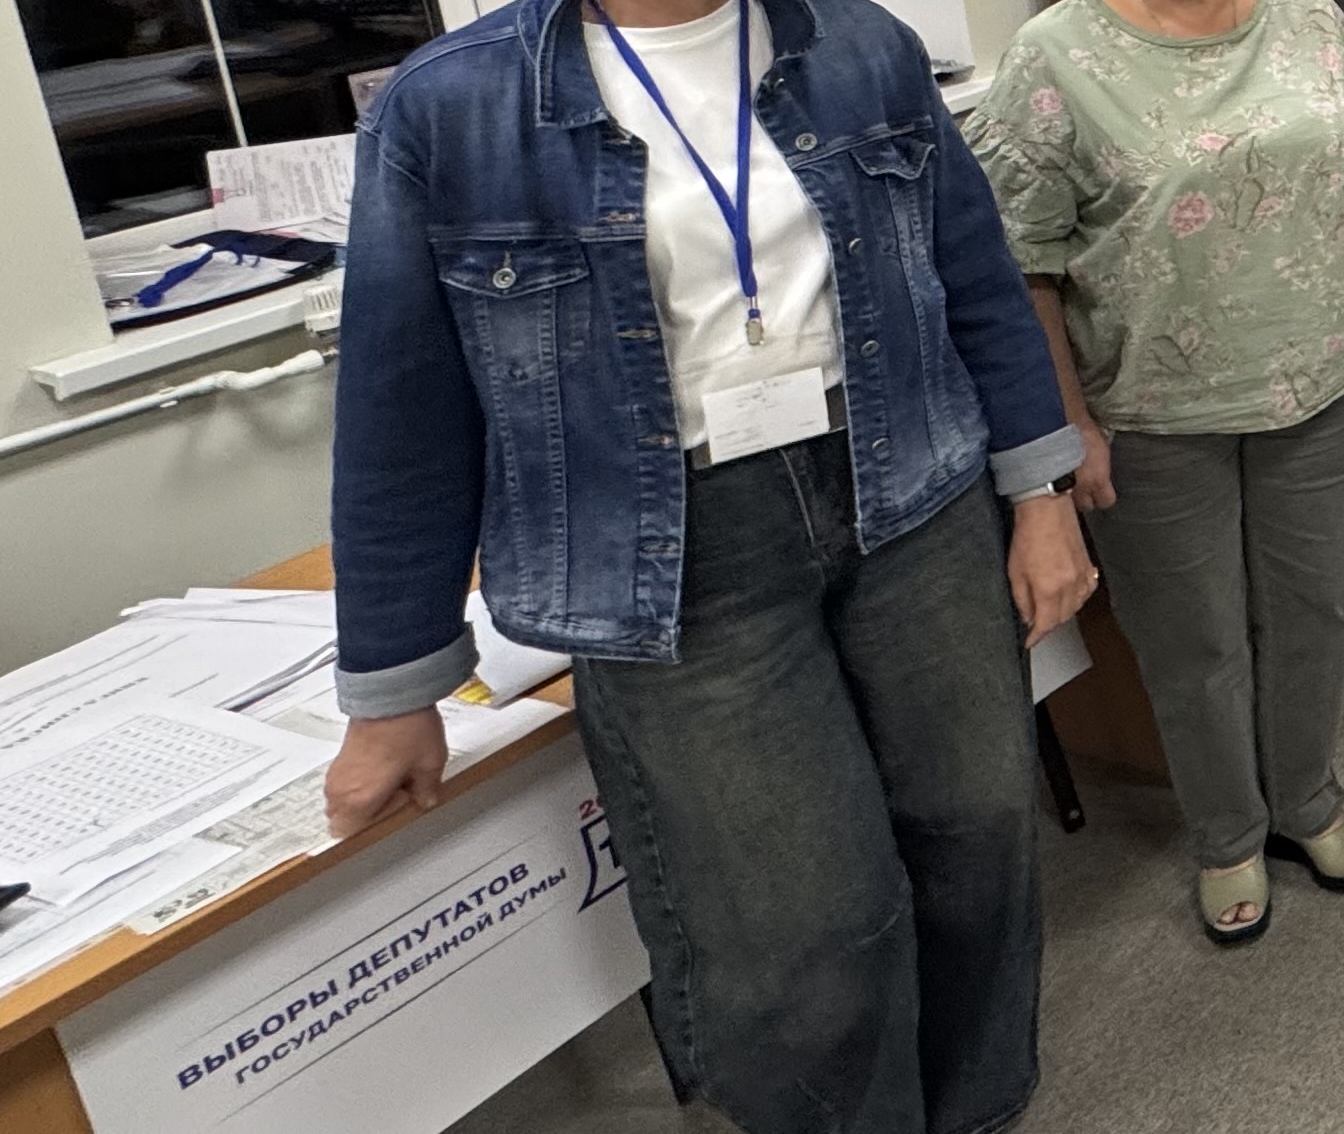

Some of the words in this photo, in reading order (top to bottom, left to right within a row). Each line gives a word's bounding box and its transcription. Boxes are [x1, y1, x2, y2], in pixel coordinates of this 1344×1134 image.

[177, 978, 339, 1091] ВЫБОРЫ
[349, 863, 530, 989] ДЕПУТАТОВ
[234, 910, 494, 1085] ГОСУДАРСТВЕННОЙ
[500, 867, 567, 921] ДУМЫ
